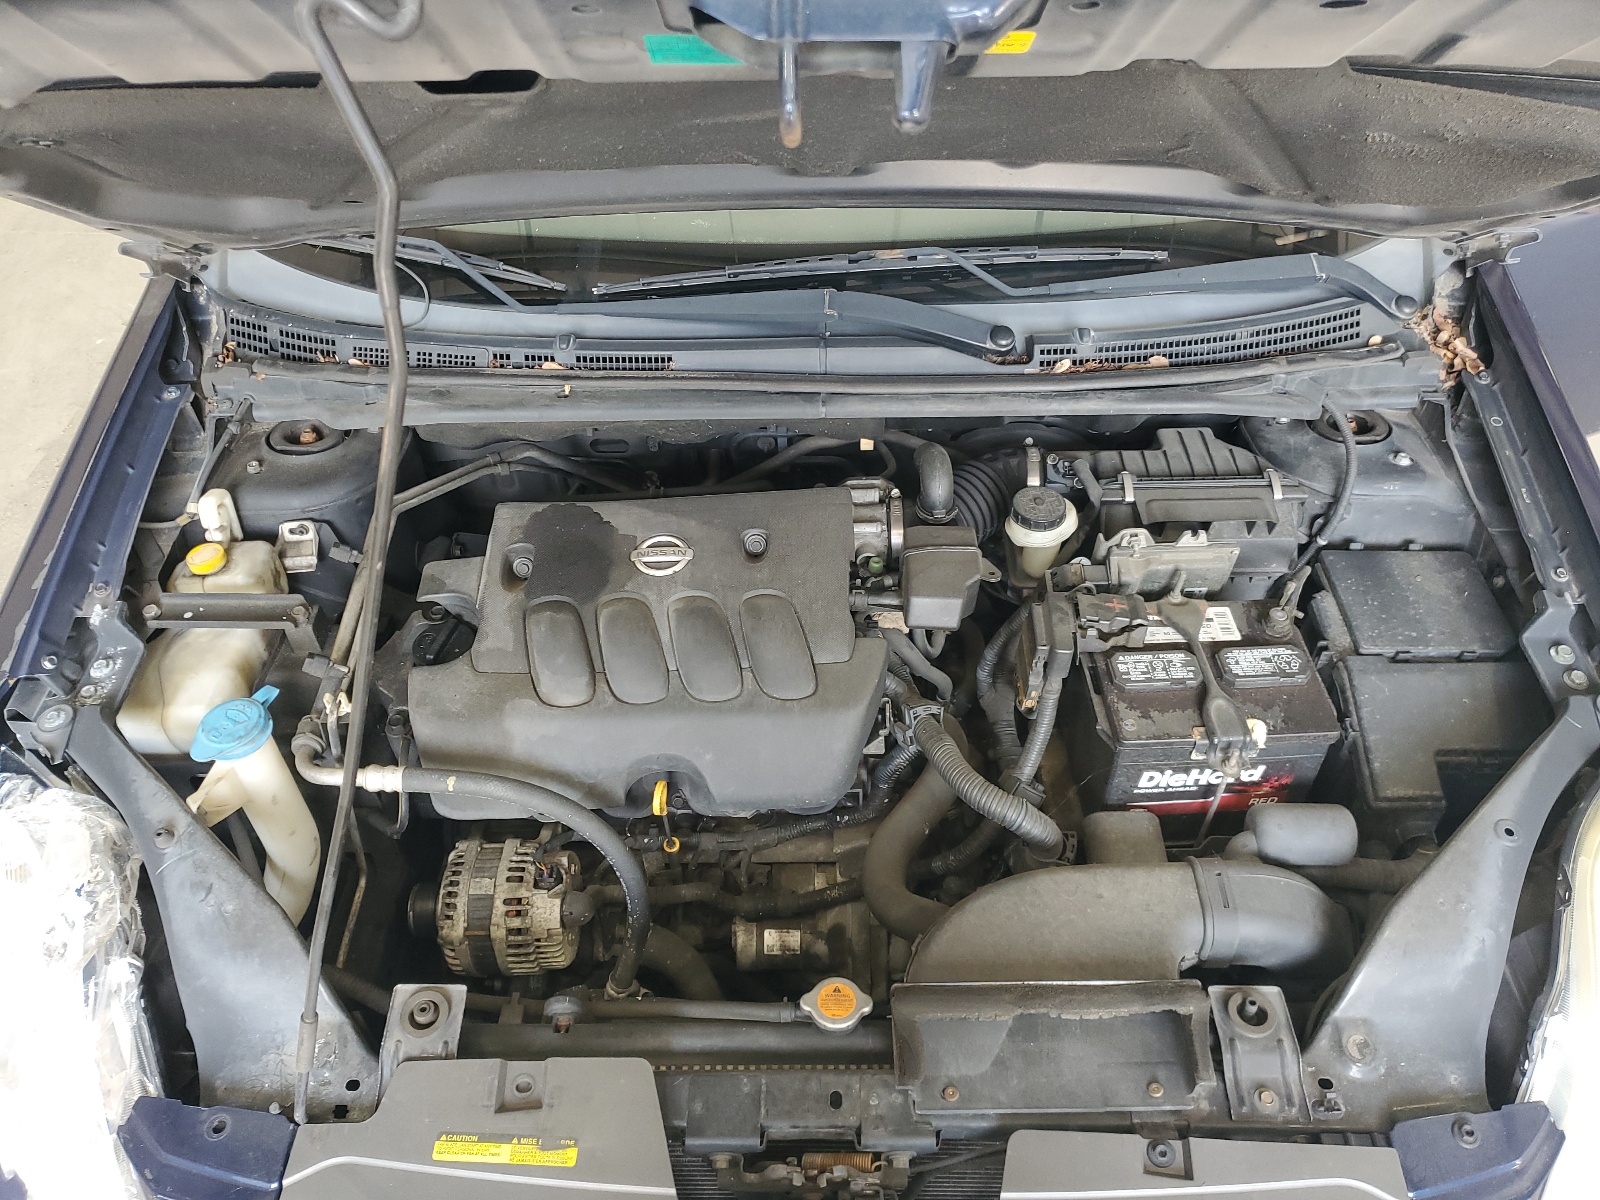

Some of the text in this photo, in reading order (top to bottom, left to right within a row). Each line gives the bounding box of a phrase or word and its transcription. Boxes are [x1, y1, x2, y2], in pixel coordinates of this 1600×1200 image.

[636, 549, 687, 557] NISSAN
[1137, 765, 1267, 788] DieHad
[447, 1134, 479, 1142] CAUTION
